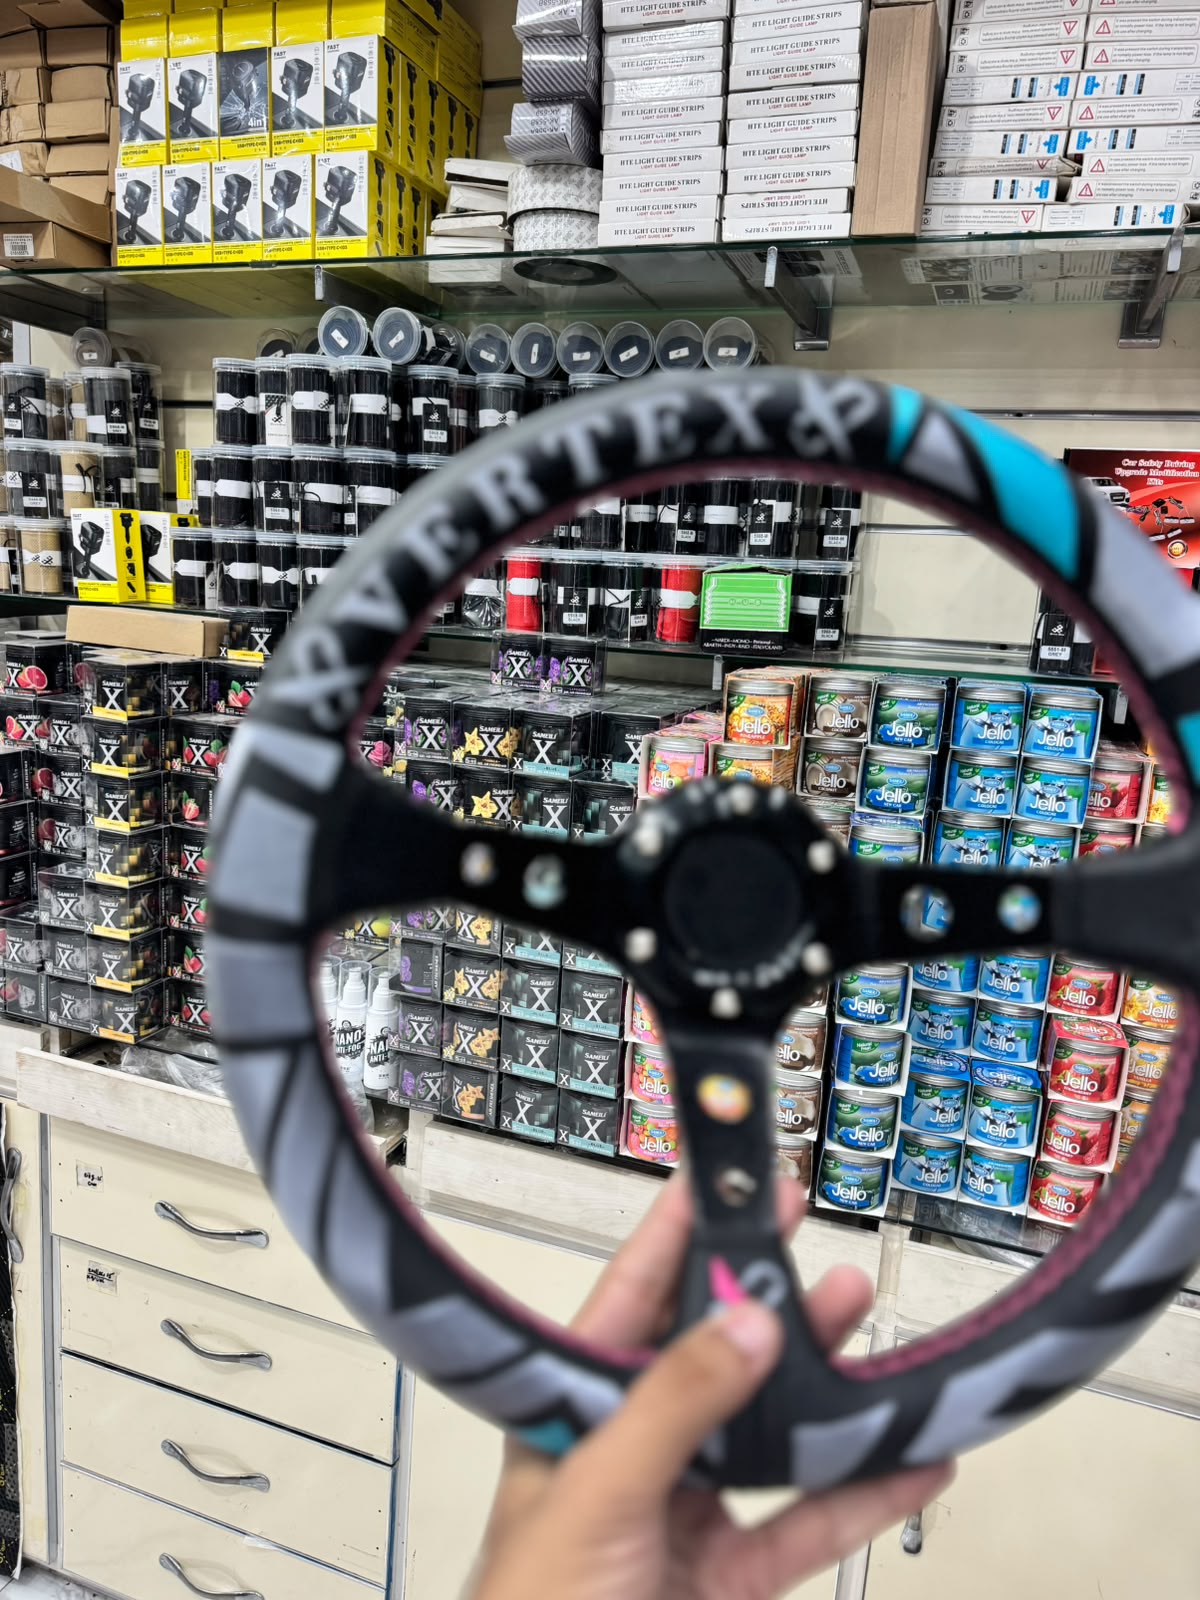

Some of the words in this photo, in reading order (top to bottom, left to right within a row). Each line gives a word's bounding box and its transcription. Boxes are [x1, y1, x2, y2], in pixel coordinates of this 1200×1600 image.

[250, 633, 272, 656] X
[508, 656, 528, 679] X
[568, 664, 590, 687] X
[101, 687, 124, 711] X
[18, 720, 40, 740] X
[735, 718, 771, 735] Jello
[827, 713, 859, 729] Jello
[886, 719, 923, 740] Jello
[420, 725, 443, 750] X
[977, 724, 1012, 740] Jello
[1037, 730, 1074, 748] Jello
[480, 733, 503, 758] X
[531, 738, 557, 765] X
[188, 744, 210, 767] X
[814, 773, 846, 789] Jello
[875, 786, 912, 804] Jello
[970, 786, 1006, 805] Jello
[1029, 793, 1065, 814] Jello
[104, 800, 127, 821] X
[542, 805, 568, 830] X
[465, 974, 488, 1000] X
[987, 975, 1020, 993] Jello
[529, 987, 553, 1012] X
[848, 998, 886, 1016] Jello
[1059, 988, 1096, 1007] Jello
[582, 998, 607, 1023] X
[114, 1012, 137, 1034] X
[920, 1023, 954, 1041] Jello
[408, 1021, 432, 1046] X
[982, 1034, 1016, 1052] Jello
[525, 1043, 550, 1070] X
[584, 1059, 609, 1086] X
[869, 1061, 899, 1078] Jello
[1128, 1061, 1163, 1080] Jello
[639, 1078, 670, 1095] Jello
[1061, 1073, 1098, 1092] Jello
[929, 1108, 961, 1125] Jello
[581, 1116, 606, 1142] X
[849, 1125, 885, 1143] Jello
[980, 1120, 1016, 1139] Jello
[640, 1136, 671, 1153] Jello
[1046, 1135, 1081, 1156] Jello
[916, 1168, 949, 1185] Jello
[963, 1176, 994, 1195] Jello
[831, 1182, 867, 1201] Jello
[1039, 1196, 1075, 1214] Jello
